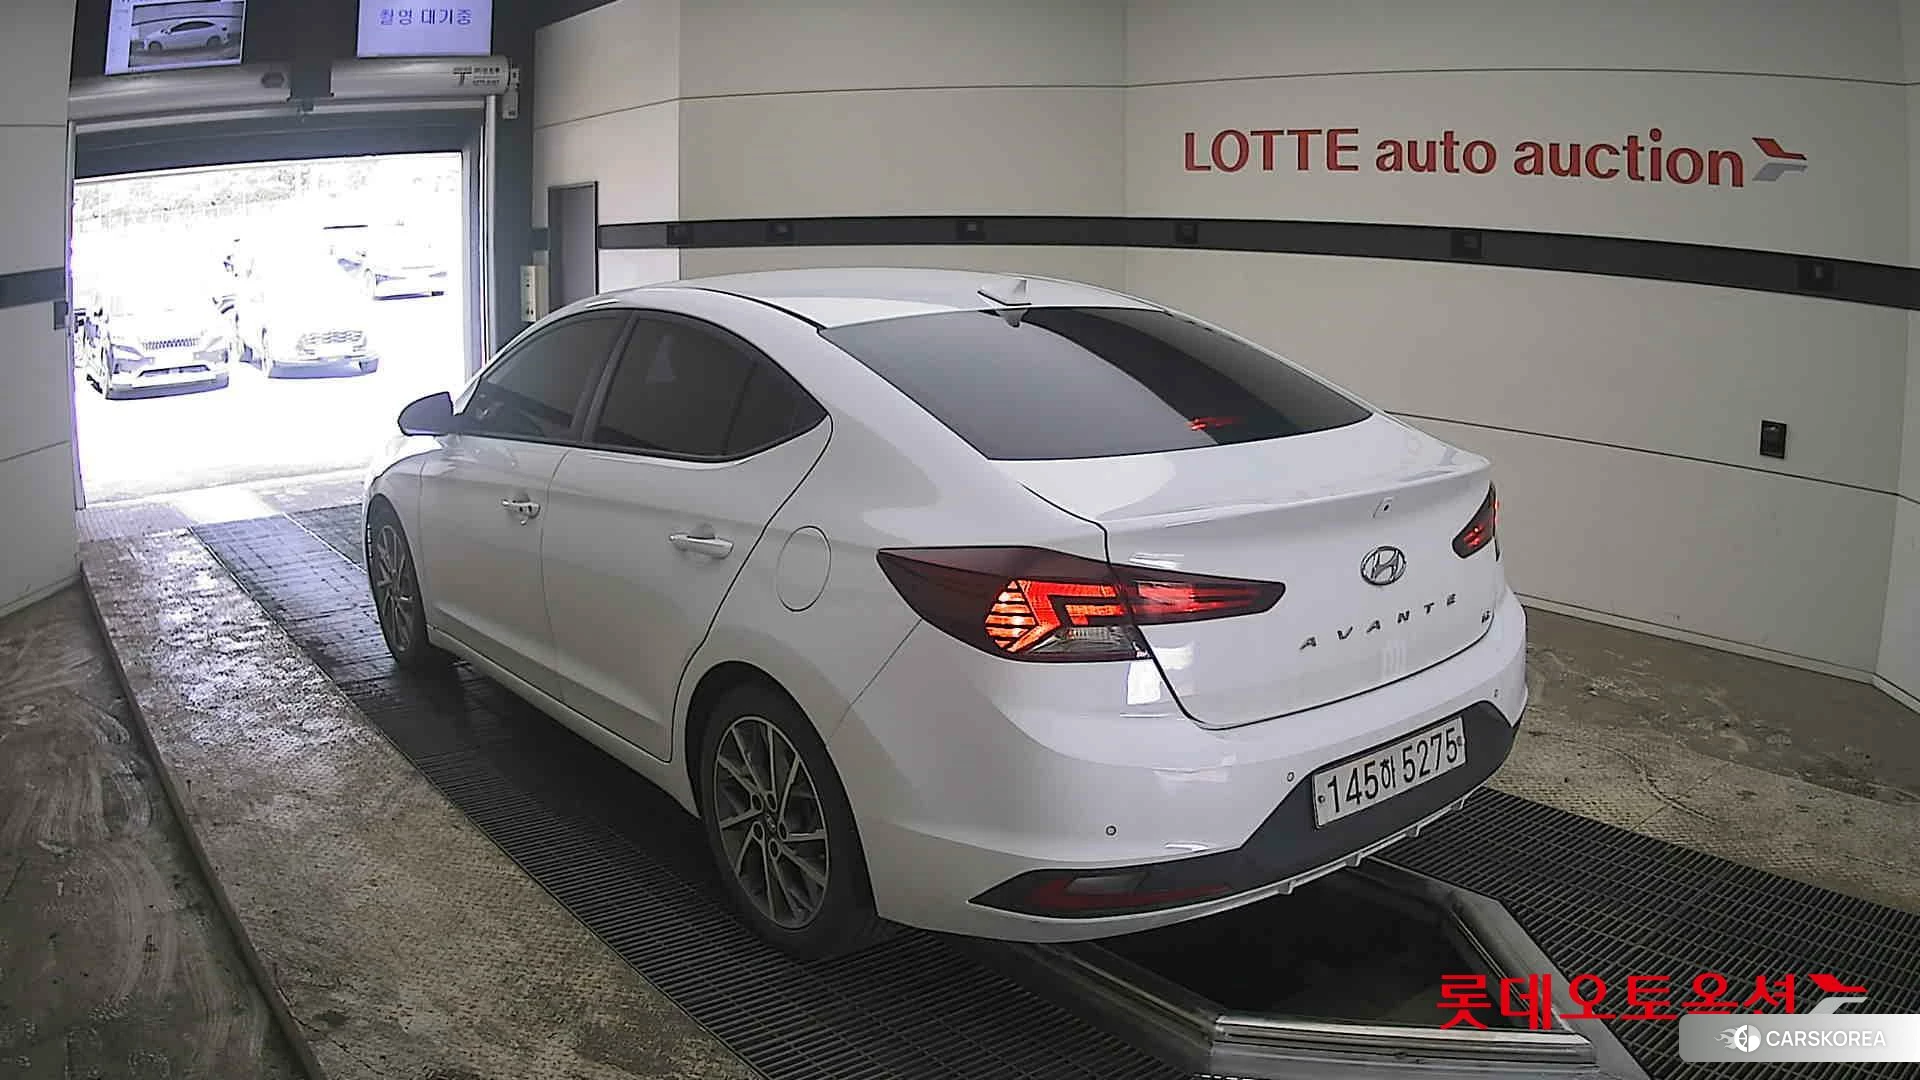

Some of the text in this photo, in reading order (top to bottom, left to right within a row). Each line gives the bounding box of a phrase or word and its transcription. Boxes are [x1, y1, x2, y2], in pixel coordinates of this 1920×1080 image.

[421, 8, 473, 26] 대기중
[1184, 128, 1745, 188] LOTTE auto auction
[1299, 593, 1457, 650] AVANTE
[1402, 727, 1459, 784] 5275
